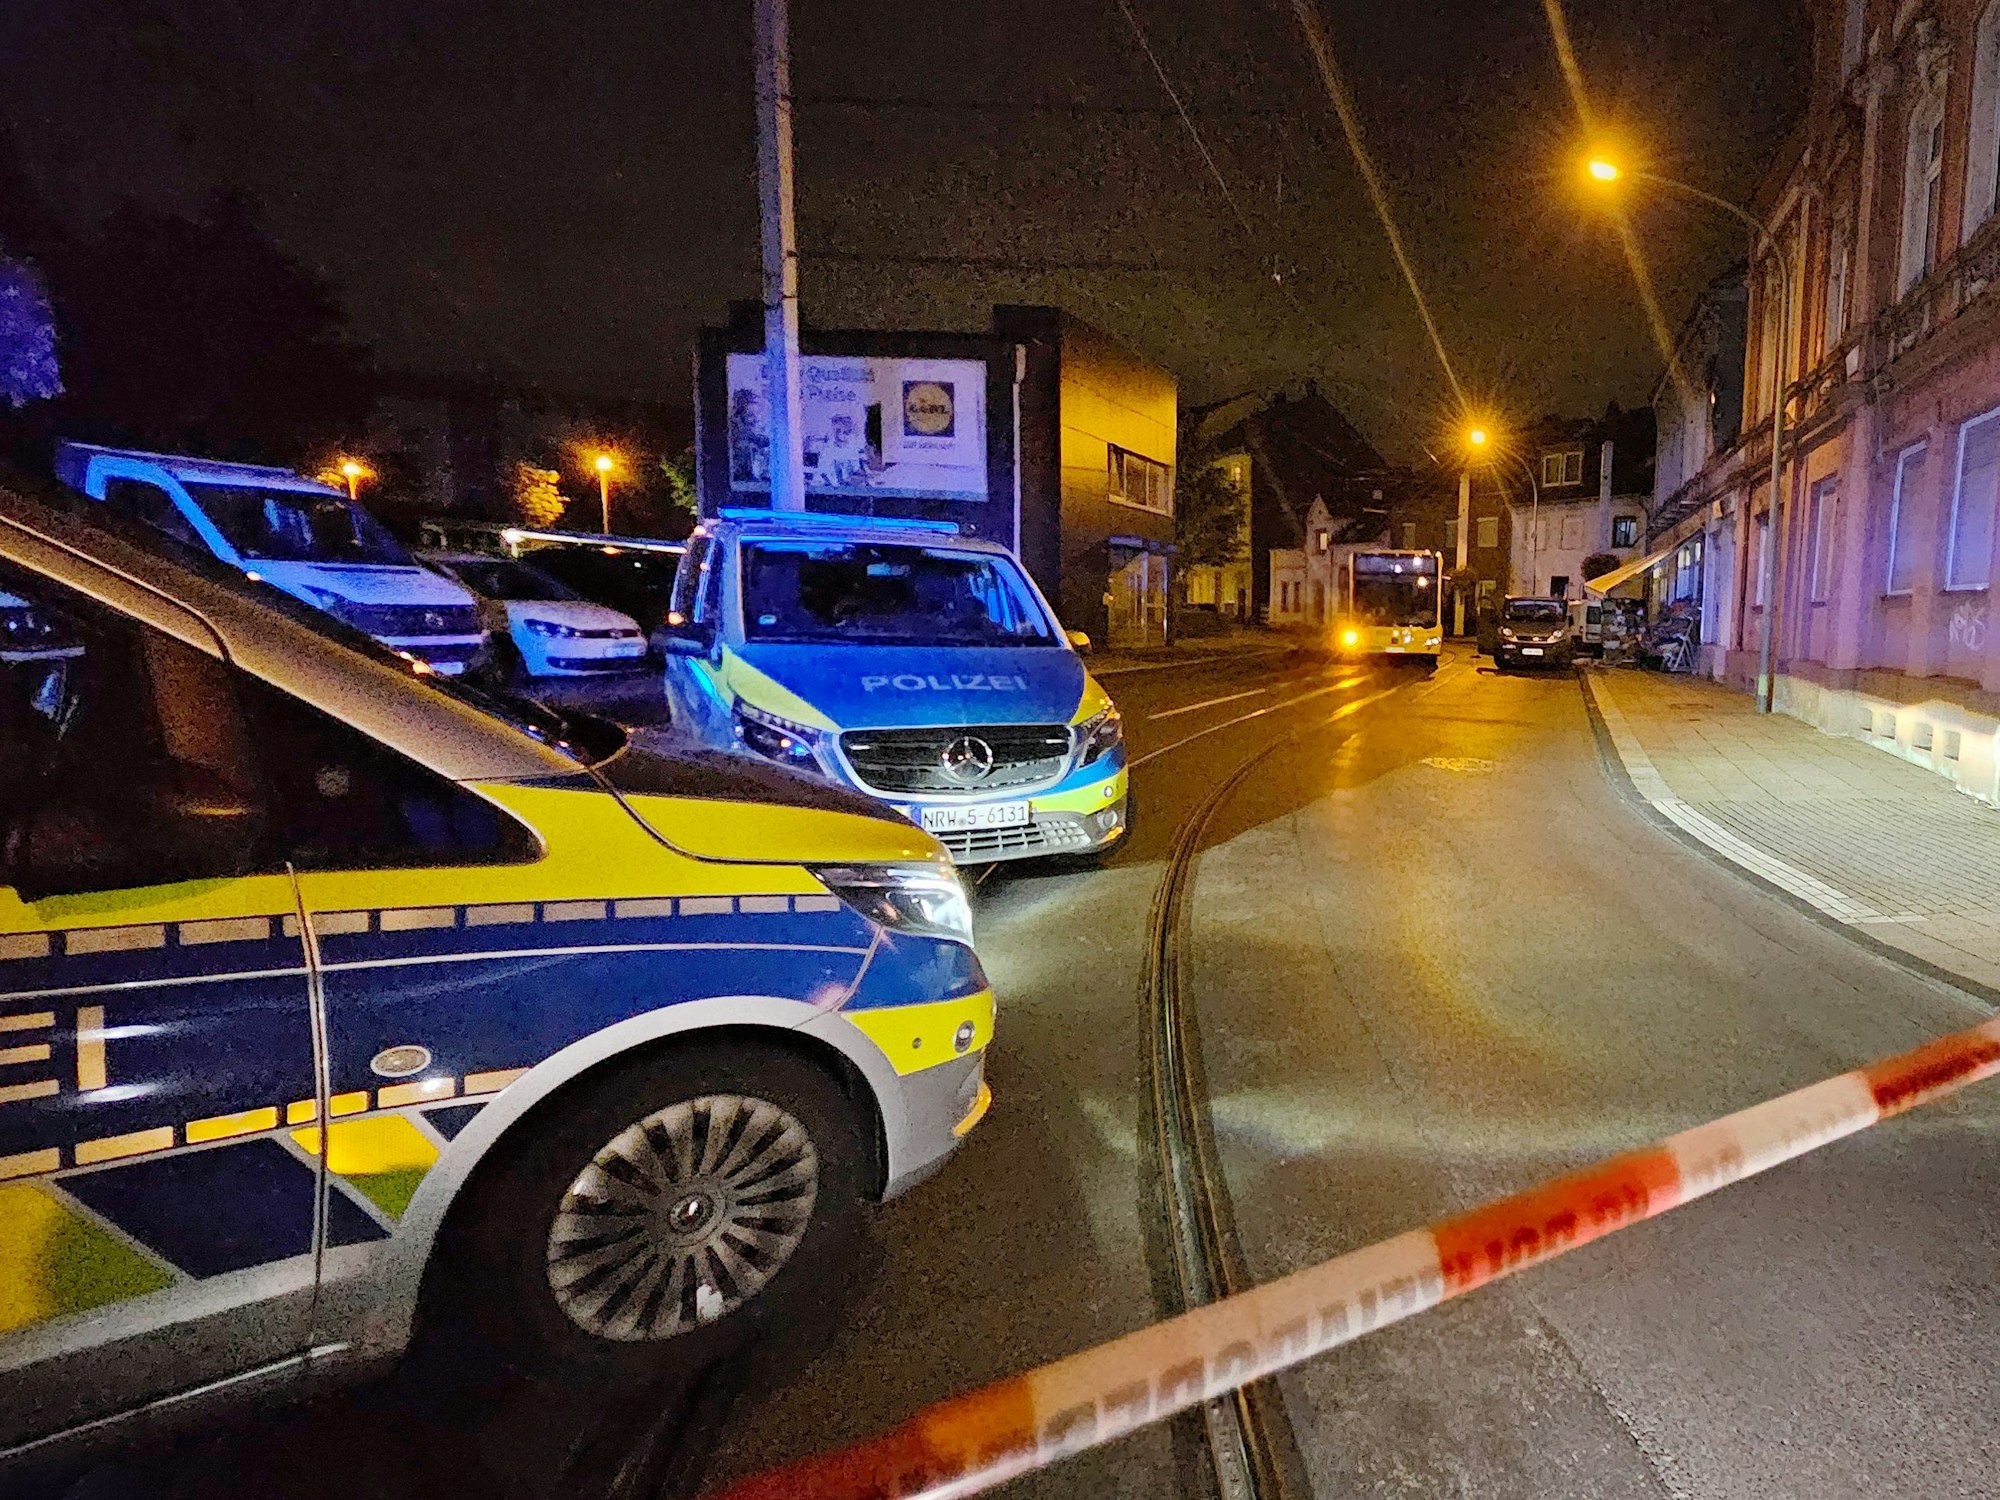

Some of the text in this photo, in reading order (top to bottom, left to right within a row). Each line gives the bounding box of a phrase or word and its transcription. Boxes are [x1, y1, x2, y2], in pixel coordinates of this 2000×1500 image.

[861, 674, 1028, 692] POLIZEI
[923, 806, 1026, 828] NRW 5-6131
